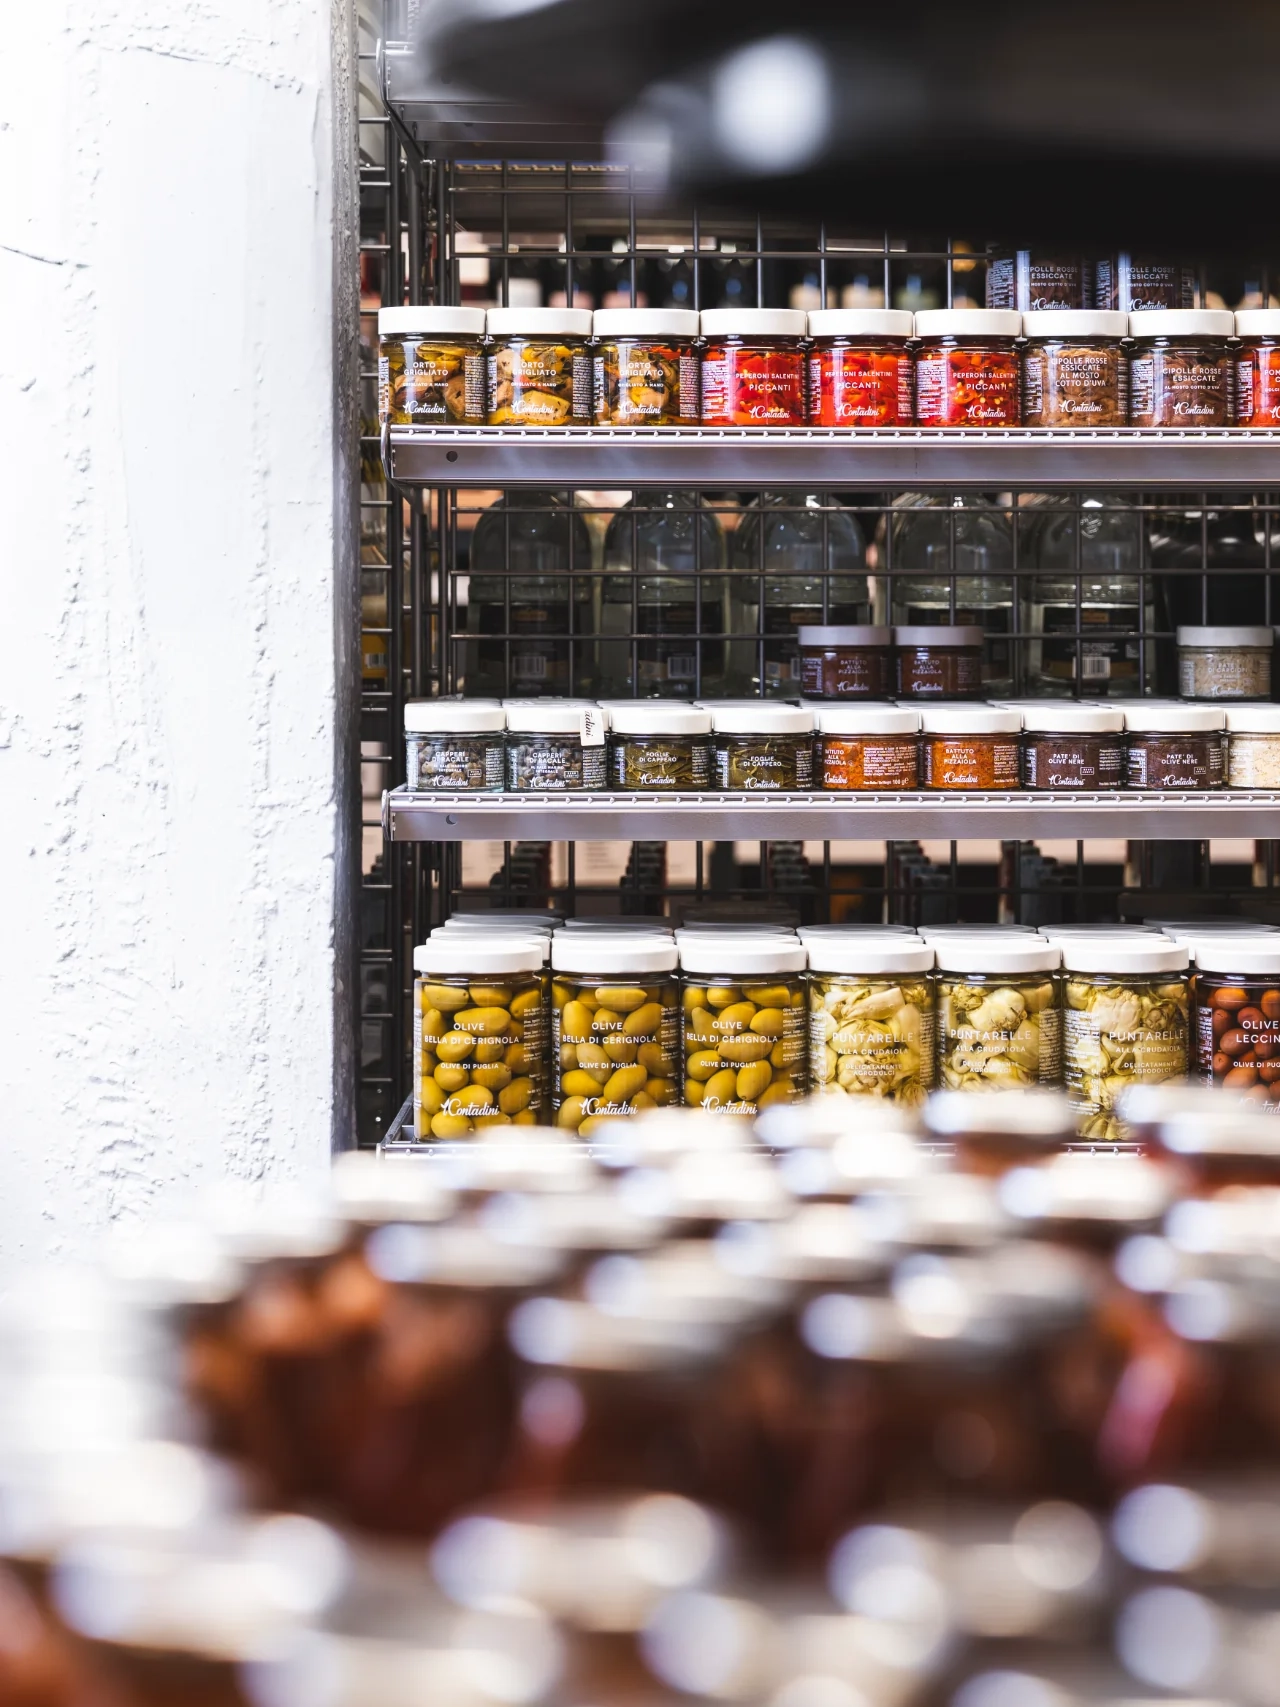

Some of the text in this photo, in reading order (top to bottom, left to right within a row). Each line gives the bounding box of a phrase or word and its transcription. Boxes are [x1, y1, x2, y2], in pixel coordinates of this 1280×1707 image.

[1051, 357, 1083, 365] CIPOLLE
[1060, 371, 1100, 379] AL MOSTO
[966, 383, 1007, 391] PICCANTI
[1055, 379, 1106, 387] COTTO D'UVA
[453, 1022, 485, 1031] OLIVE
[591, 1022, 623, 1030] OLIVE
[712, 1021, 742, 1030] OLIVE
[1242, 1020, 1279, 1030] OLIVE
[562, 1035, 657, 1044] BELLA DI CERIGNOLA
[686, 1032, 778, 1044] BELLA DI CERIGNOLA
[832, 1032, 913, 1043] PUNTARELLE
[950, 1030, 1031, 1041] PUNTARELLE
[1109, 1029, 1184, 1041] PUNTARELLE
[424, 1035, 519, 1045] BELLA DI CERIGNOLA
[700, 1060, 719, 1068] OLIVE
